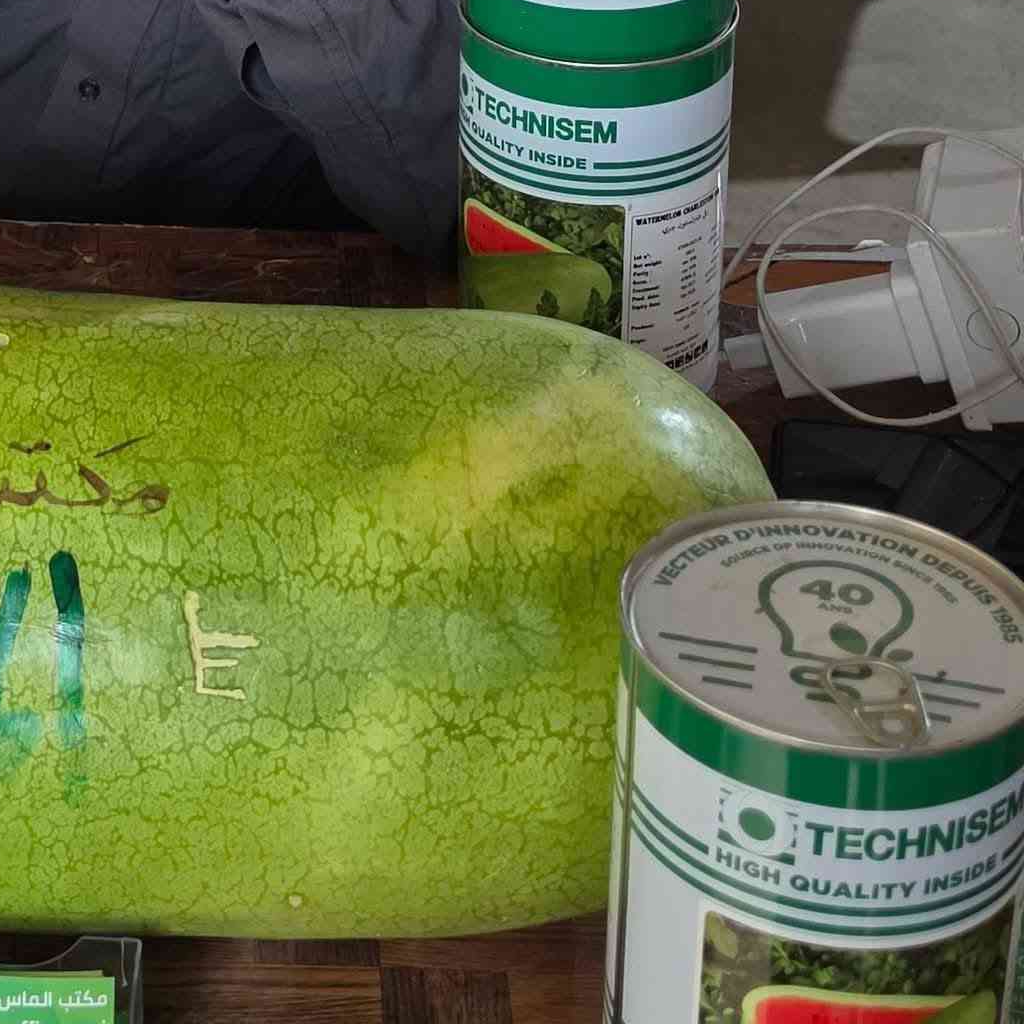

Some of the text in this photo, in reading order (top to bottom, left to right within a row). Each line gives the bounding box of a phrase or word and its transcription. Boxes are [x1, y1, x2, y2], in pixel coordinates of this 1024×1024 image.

[475, 86, 618, 144] TECHNISEM
[471, 121, 524, 157] QUALITY
[529, 148, 587, 170] INSIDE
[720, 544, 771, 568] SOURCE
[795, 541, 891, 563] INNOVATION
[653, 524, 1024, 644] VECTEUR D'INNOVATION DEPUIS 1985
[800, 579, 875, 606] 40
[817, 601, 854, 615] ANS
[806, 779, 1024, 862] TECHNISEM
[716, 845, 998, 901] HIGH QUALITY INSIDE
[58, 989, 108, 1013] مكتب
